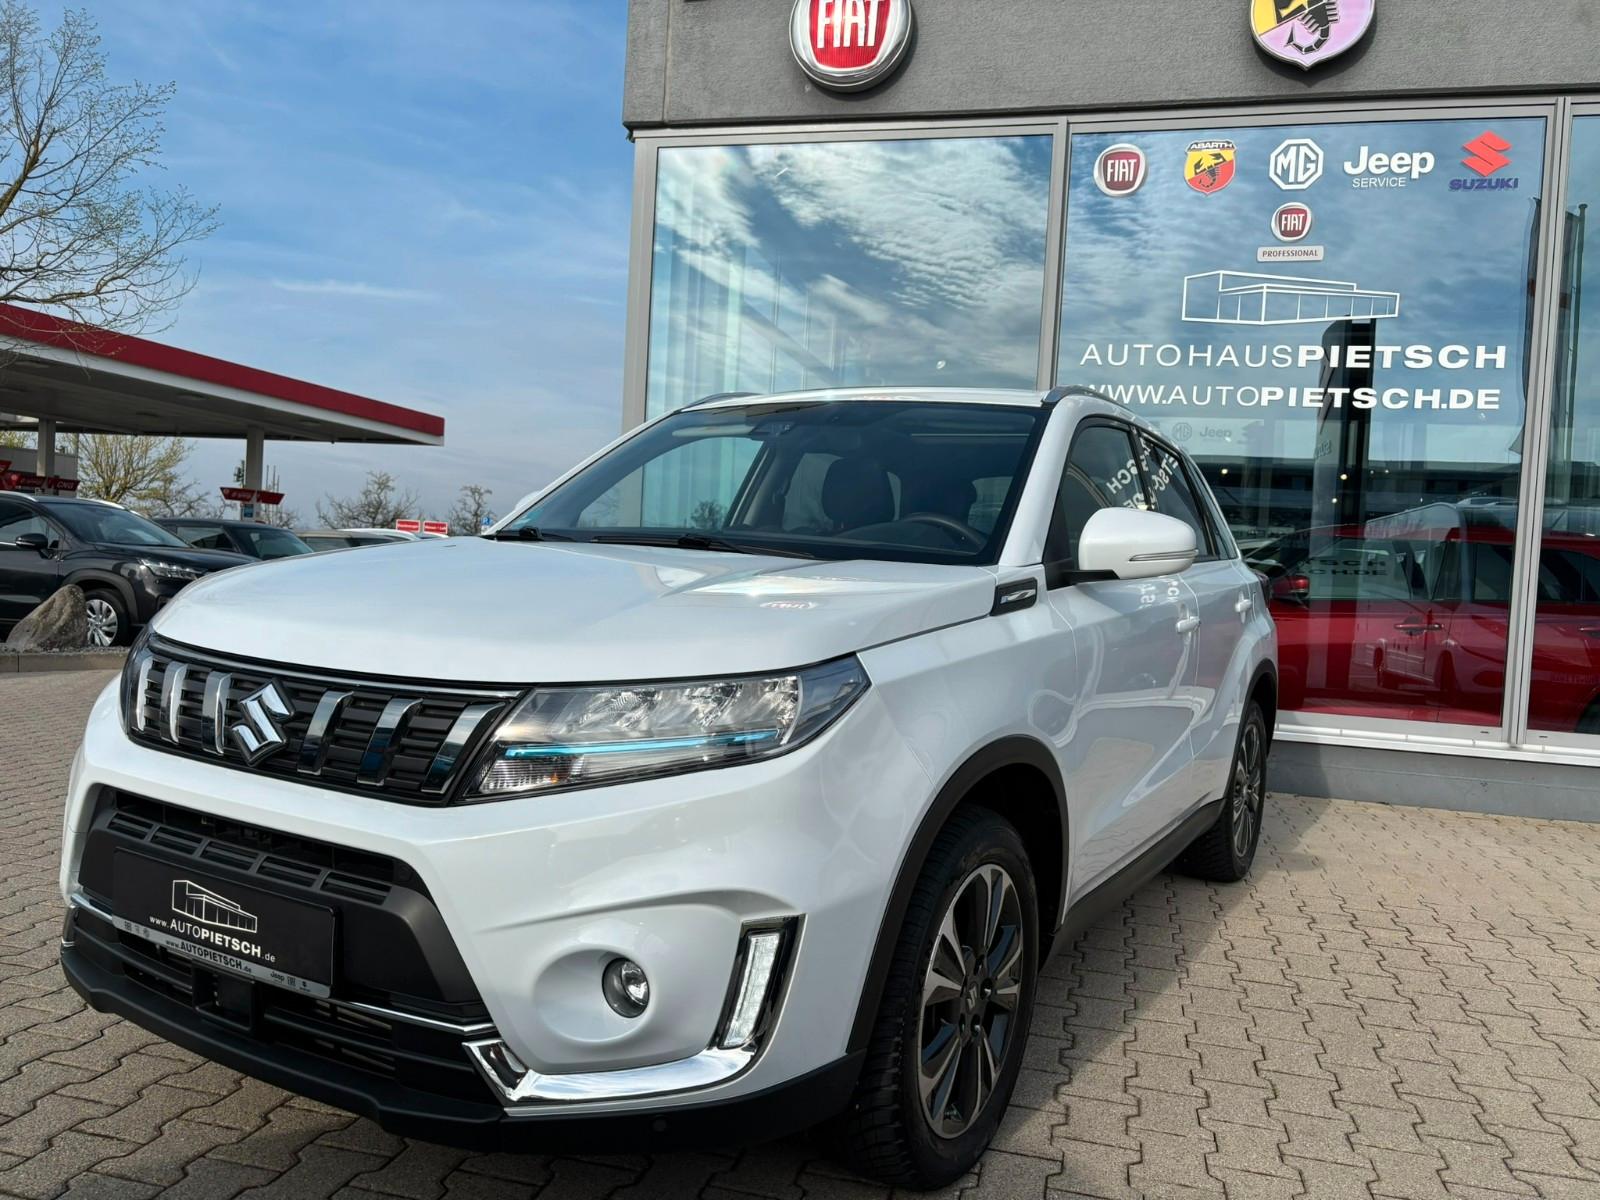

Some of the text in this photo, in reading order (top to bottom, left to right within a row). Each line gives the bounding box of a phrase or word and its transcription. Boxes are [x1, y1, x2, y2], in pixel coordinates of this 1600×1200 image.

[817, 0, 884, 48] FIAT
[1190, 142, 1233, 150] ABARTH
[1106, 158, 1138, 182] FIAT
[1277, 146, 1318, 183] MG
[1343, 145, 1435, 179] Jeep
[1352, 177, 1406, 188] SERVICE
[1449, 178, 1519, 190] SUZUKI
[1281, 213, 1305, 231] FIAT
[1262, 249, 1319, 257] PROFESSIONAL
[149, 916, 276, 962] www.AUTOPIETSCH.de
